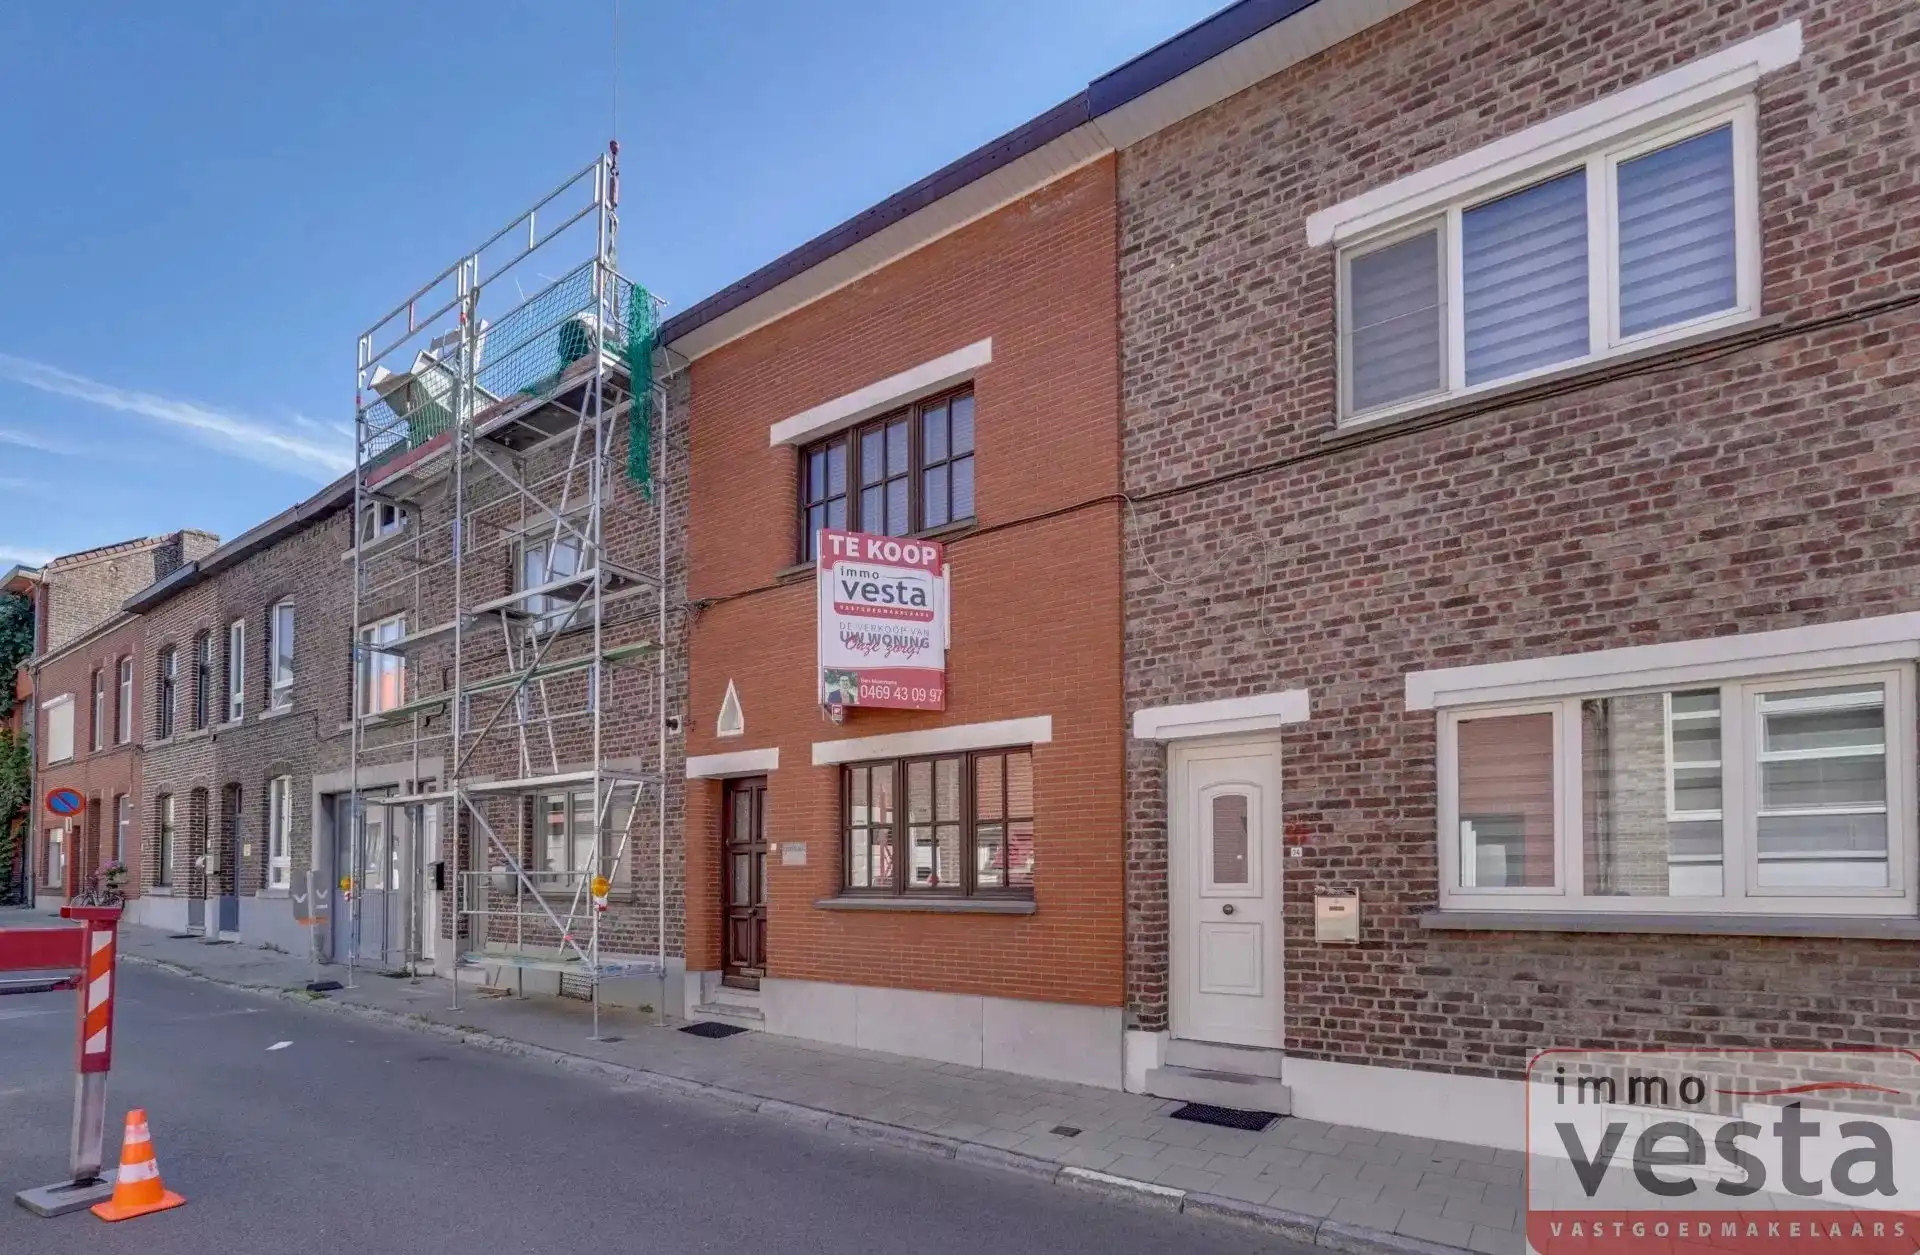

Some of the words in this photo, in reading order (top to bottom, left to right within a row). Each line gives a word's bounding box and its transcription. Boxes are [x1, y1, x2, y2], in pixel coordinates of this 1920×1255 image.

[828, 534, 860, 557] TE
[867, 539, 937, 565] KOOP
[840, 566, 879, 579] immo
[841, 580, 927, 607] vesta
[839, 605, 930, 618] VASTGOEDMAKELAARS
[839, 622, 852, 630] DE
[857, 624, 907, 635] VERKOOP
[911, 628, 930, 637] VAN
[839, 631, 864, 645] UW
[867, 633, 930, 649] WONING
[860, 684, 890, 700] 0469
[893, 687, 909, 701] 43
[911, 688, 927, 702] 09
[929, 688, 943, 702] 97
